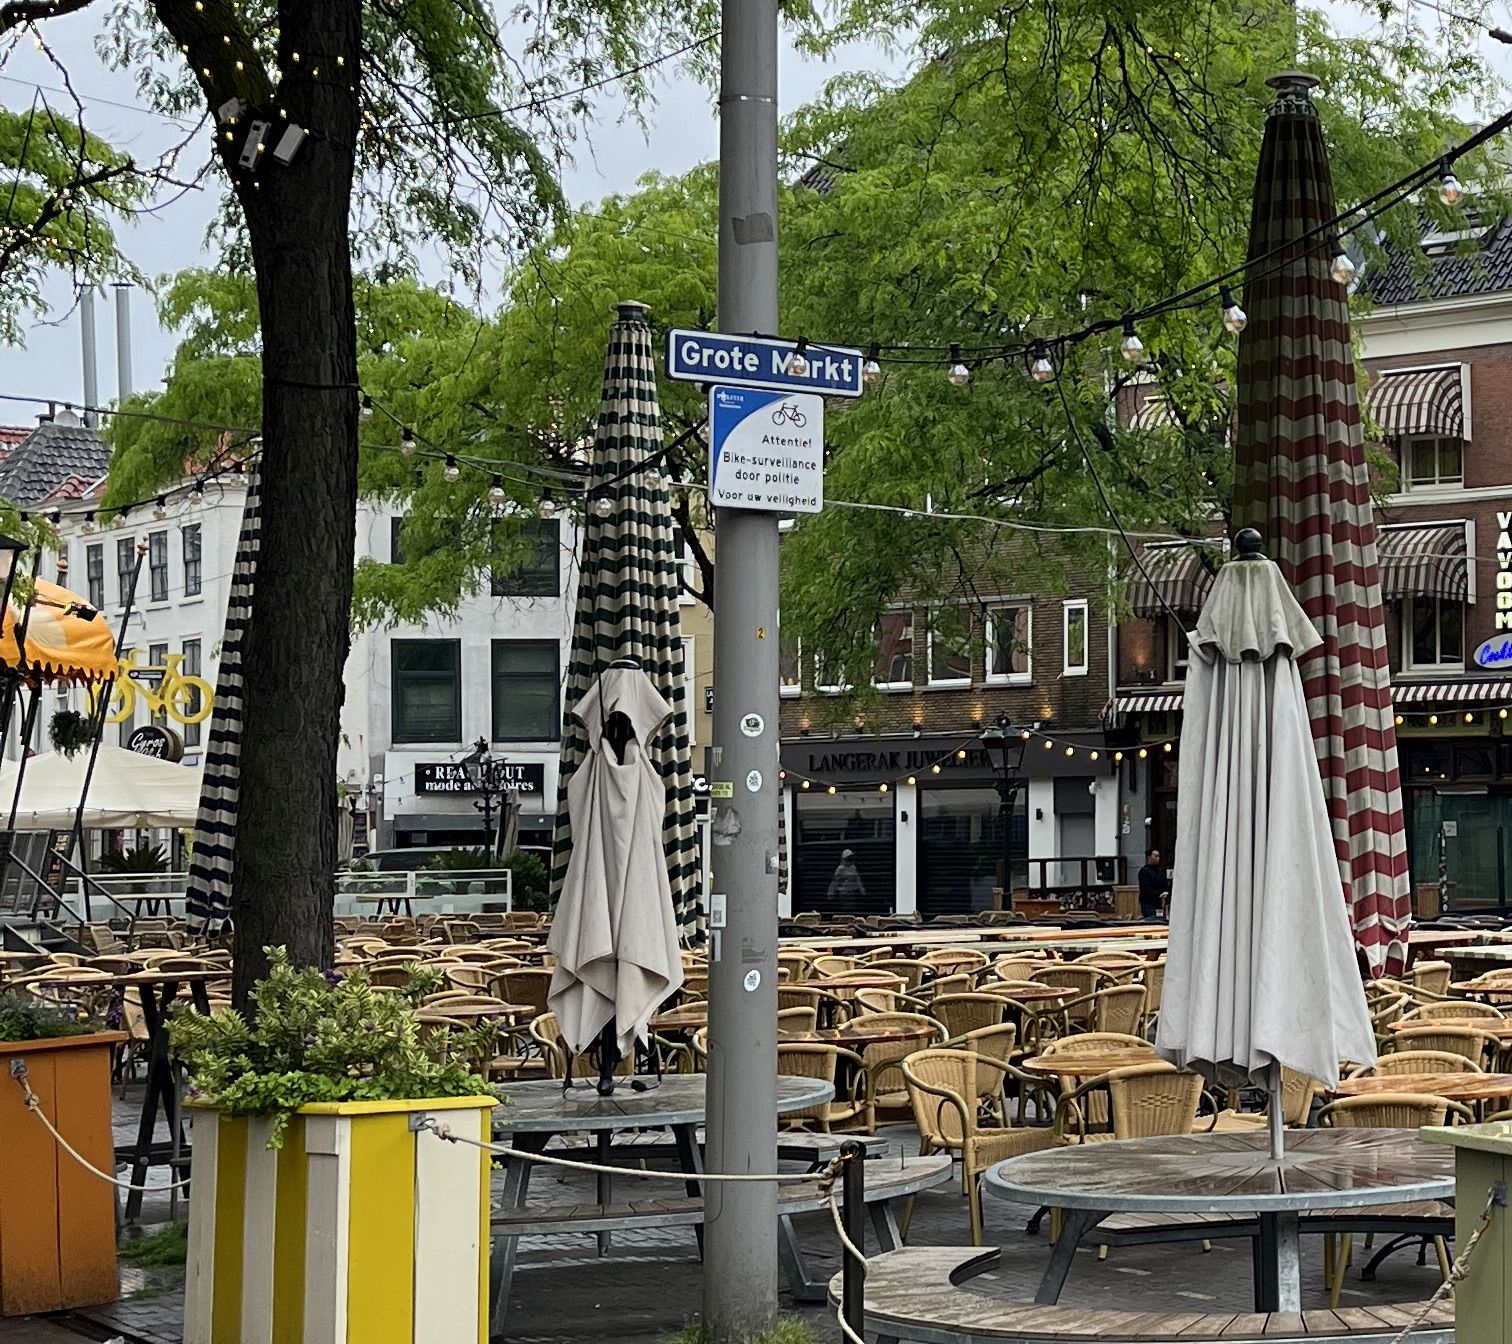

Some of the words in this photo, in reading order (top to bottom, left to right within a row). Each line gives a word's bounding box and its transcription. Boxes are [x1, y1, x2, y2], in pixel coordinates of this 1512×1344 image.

[680, 340, 760, 372] Grote
[761, 434, 813, 449] Attentie!
[723, 451, 817, 471] Bike-surveillance
[735, 469, 761, 481] door
[765, 473, 800, 485] politie
[718, 488, 743, 500] Voor
[747, 493, 761, 502] uw
[766, 495, 817, 508] veiligheid
[808, 751, 900, 773] LANGERAK
[425, 780, 462, 791] mode
